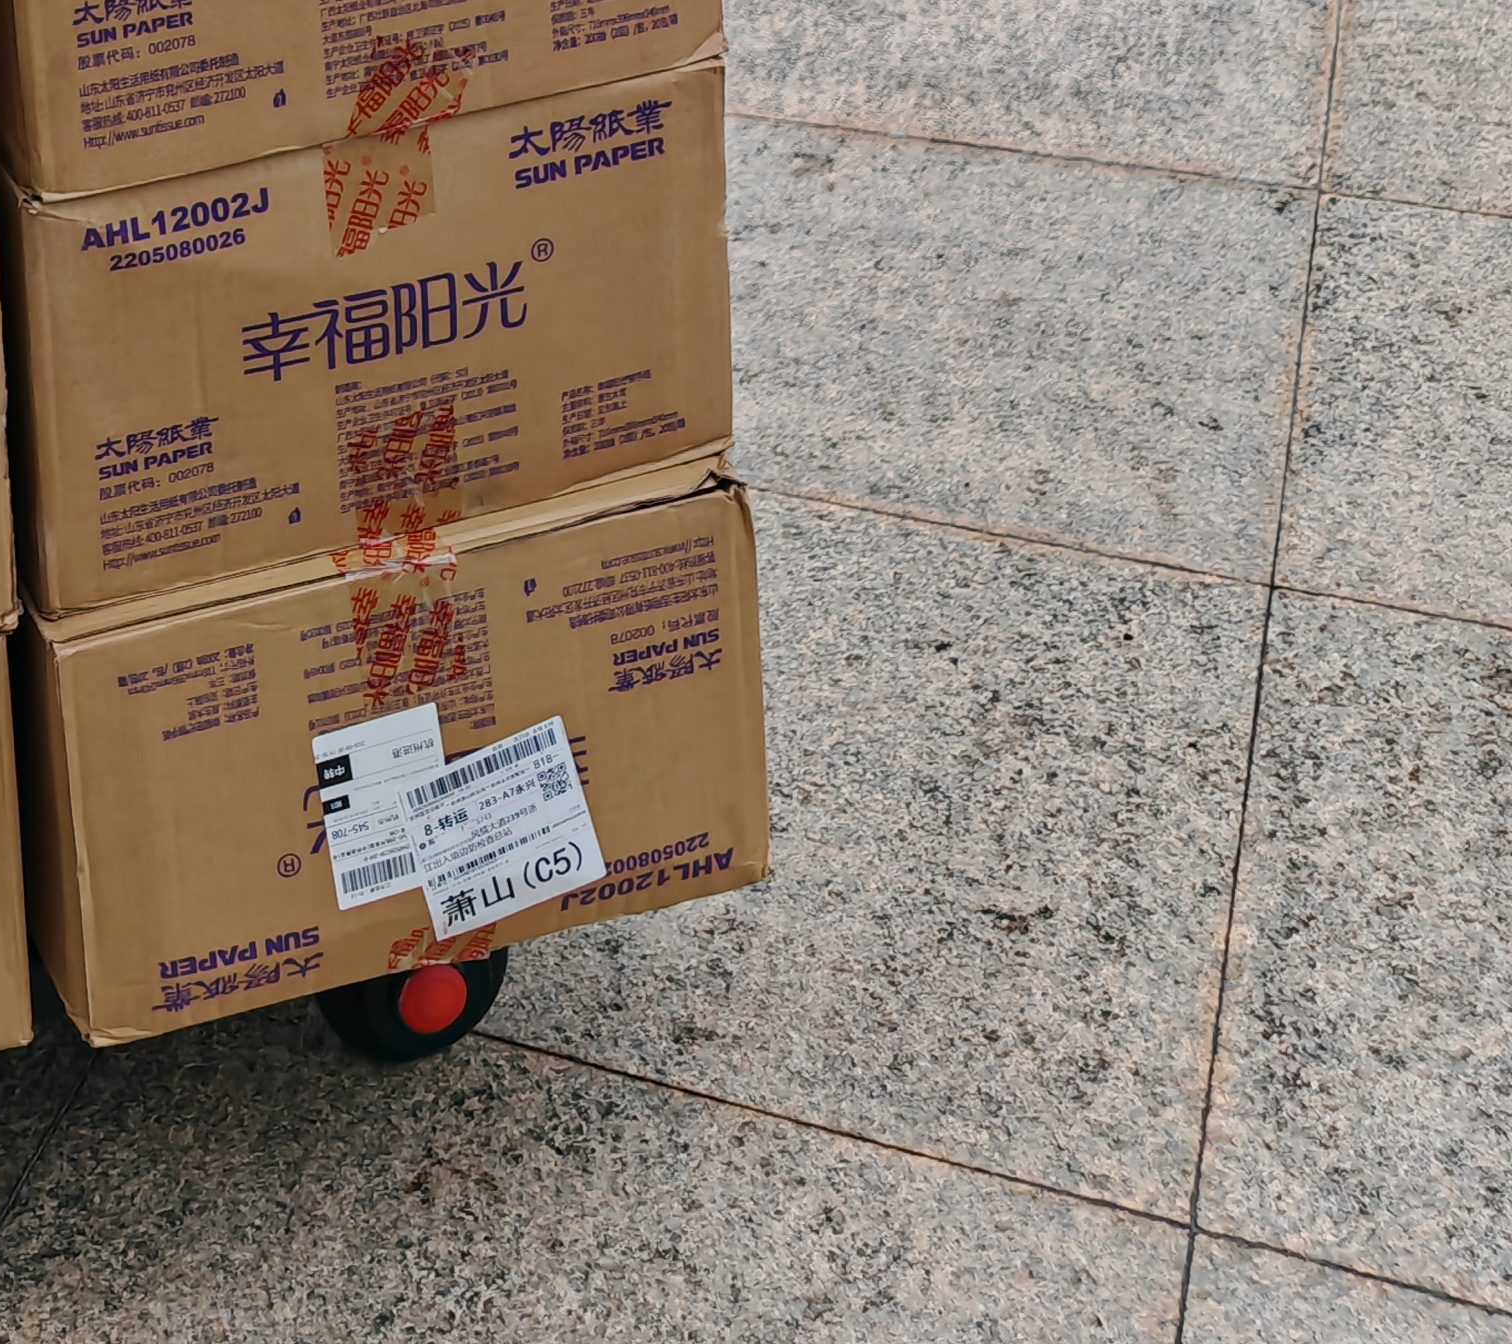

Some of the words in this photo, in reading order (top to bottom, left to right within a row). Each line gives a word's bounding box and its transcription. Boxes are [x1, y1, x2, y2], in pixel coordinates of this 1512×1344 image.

[76, 29, 116, 45] SUN
[123, 14, 193, 38] PAPER
[509, 101, 671, 159] 太陽紙業
[514, 161, 567, 189] SUN
[574, 138, 665, 174] PAPER
[82, 187, 269, 251] AHL12002J
[112, 229, 245, 273] 2205080026
[242, 263, 527, 381] 幸福阳光
[96, 418, 219, 468] 太陽紙業
[98, 461, 137, 478] SUN
[144, 445, 213, 469] PAPER
[612, 640, 677, 664] PAPER
[683, 632, 720, 648] SUN
[608, 642, 722, 691] 太陽紙業
[477, 776, 536, 812] 283-A7永兴
[330, 820, 369, 840] 545-708
[422, 806, 469, 839] 8-转运
[559, 851, 734, 914] AHL12002J
[159, 943, 257, 979] PAPER
[265, 928, 319, 954] SUN
[152, 953, 324, 1011] 太陽紙業
